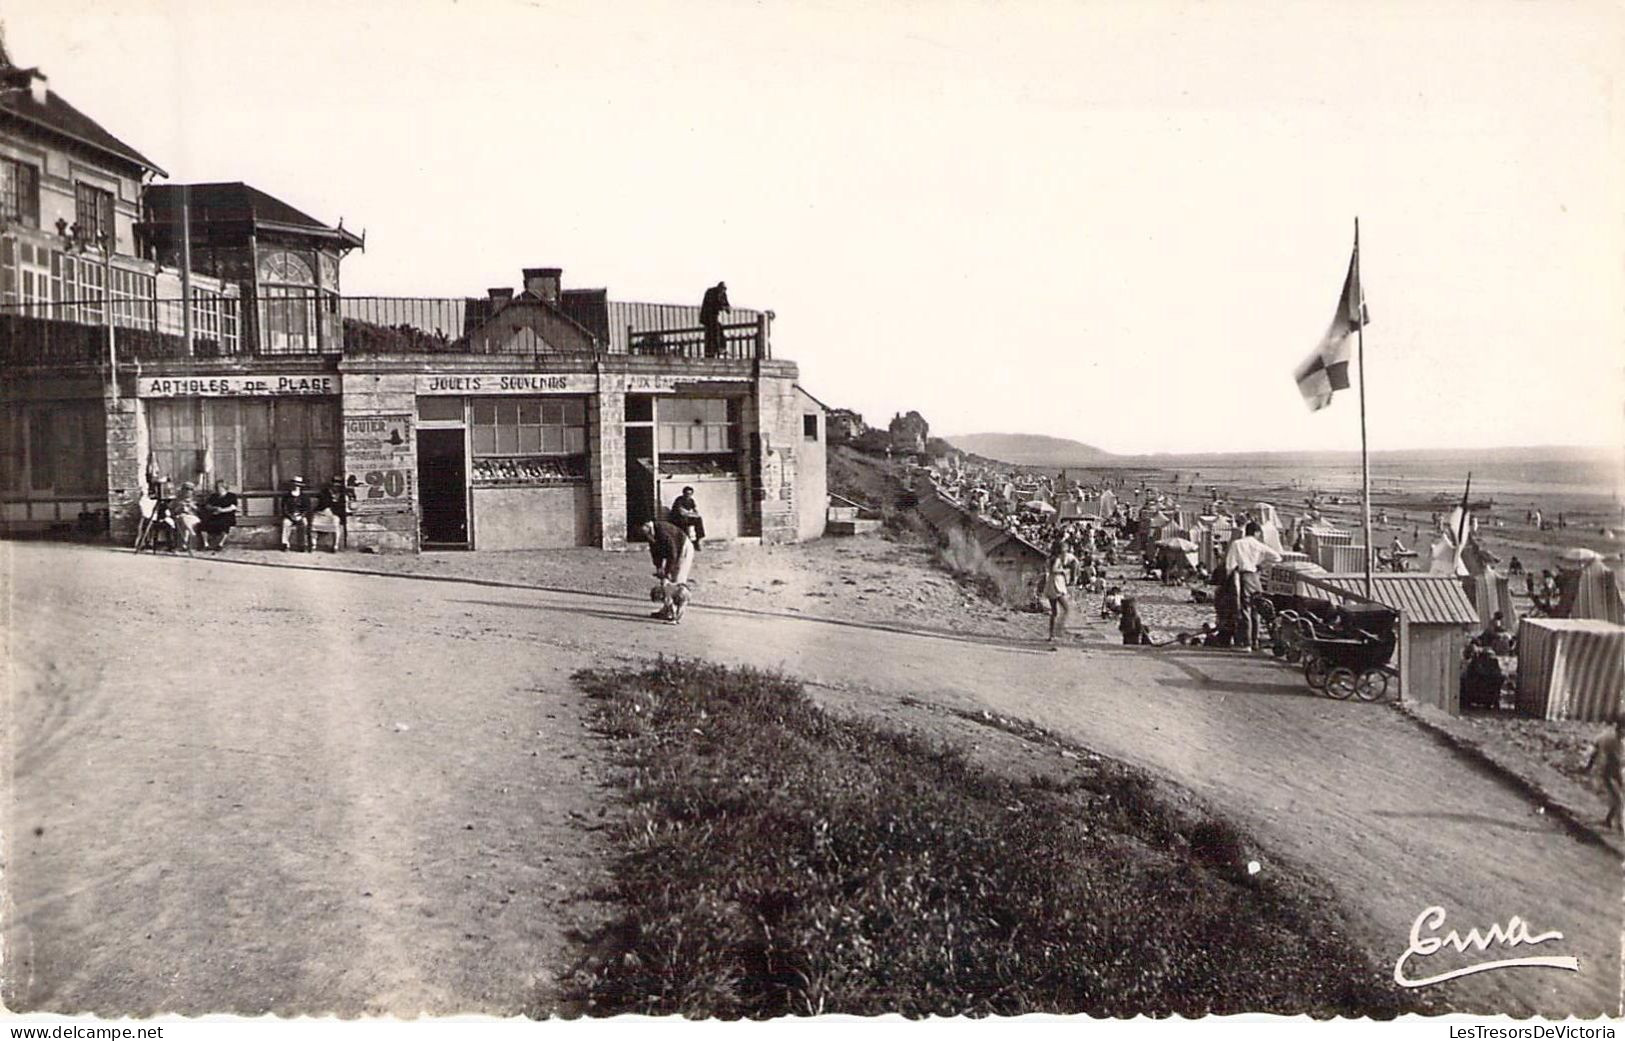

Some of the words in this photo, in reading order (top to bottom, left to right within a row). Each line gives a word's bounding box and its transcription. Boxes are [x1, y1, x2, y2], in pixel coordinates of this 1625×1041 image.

[278, 377, 331, 390] PLAGE
[429, 377, 481, 391] JOUETS
[364, 470, 405, 498] 20
